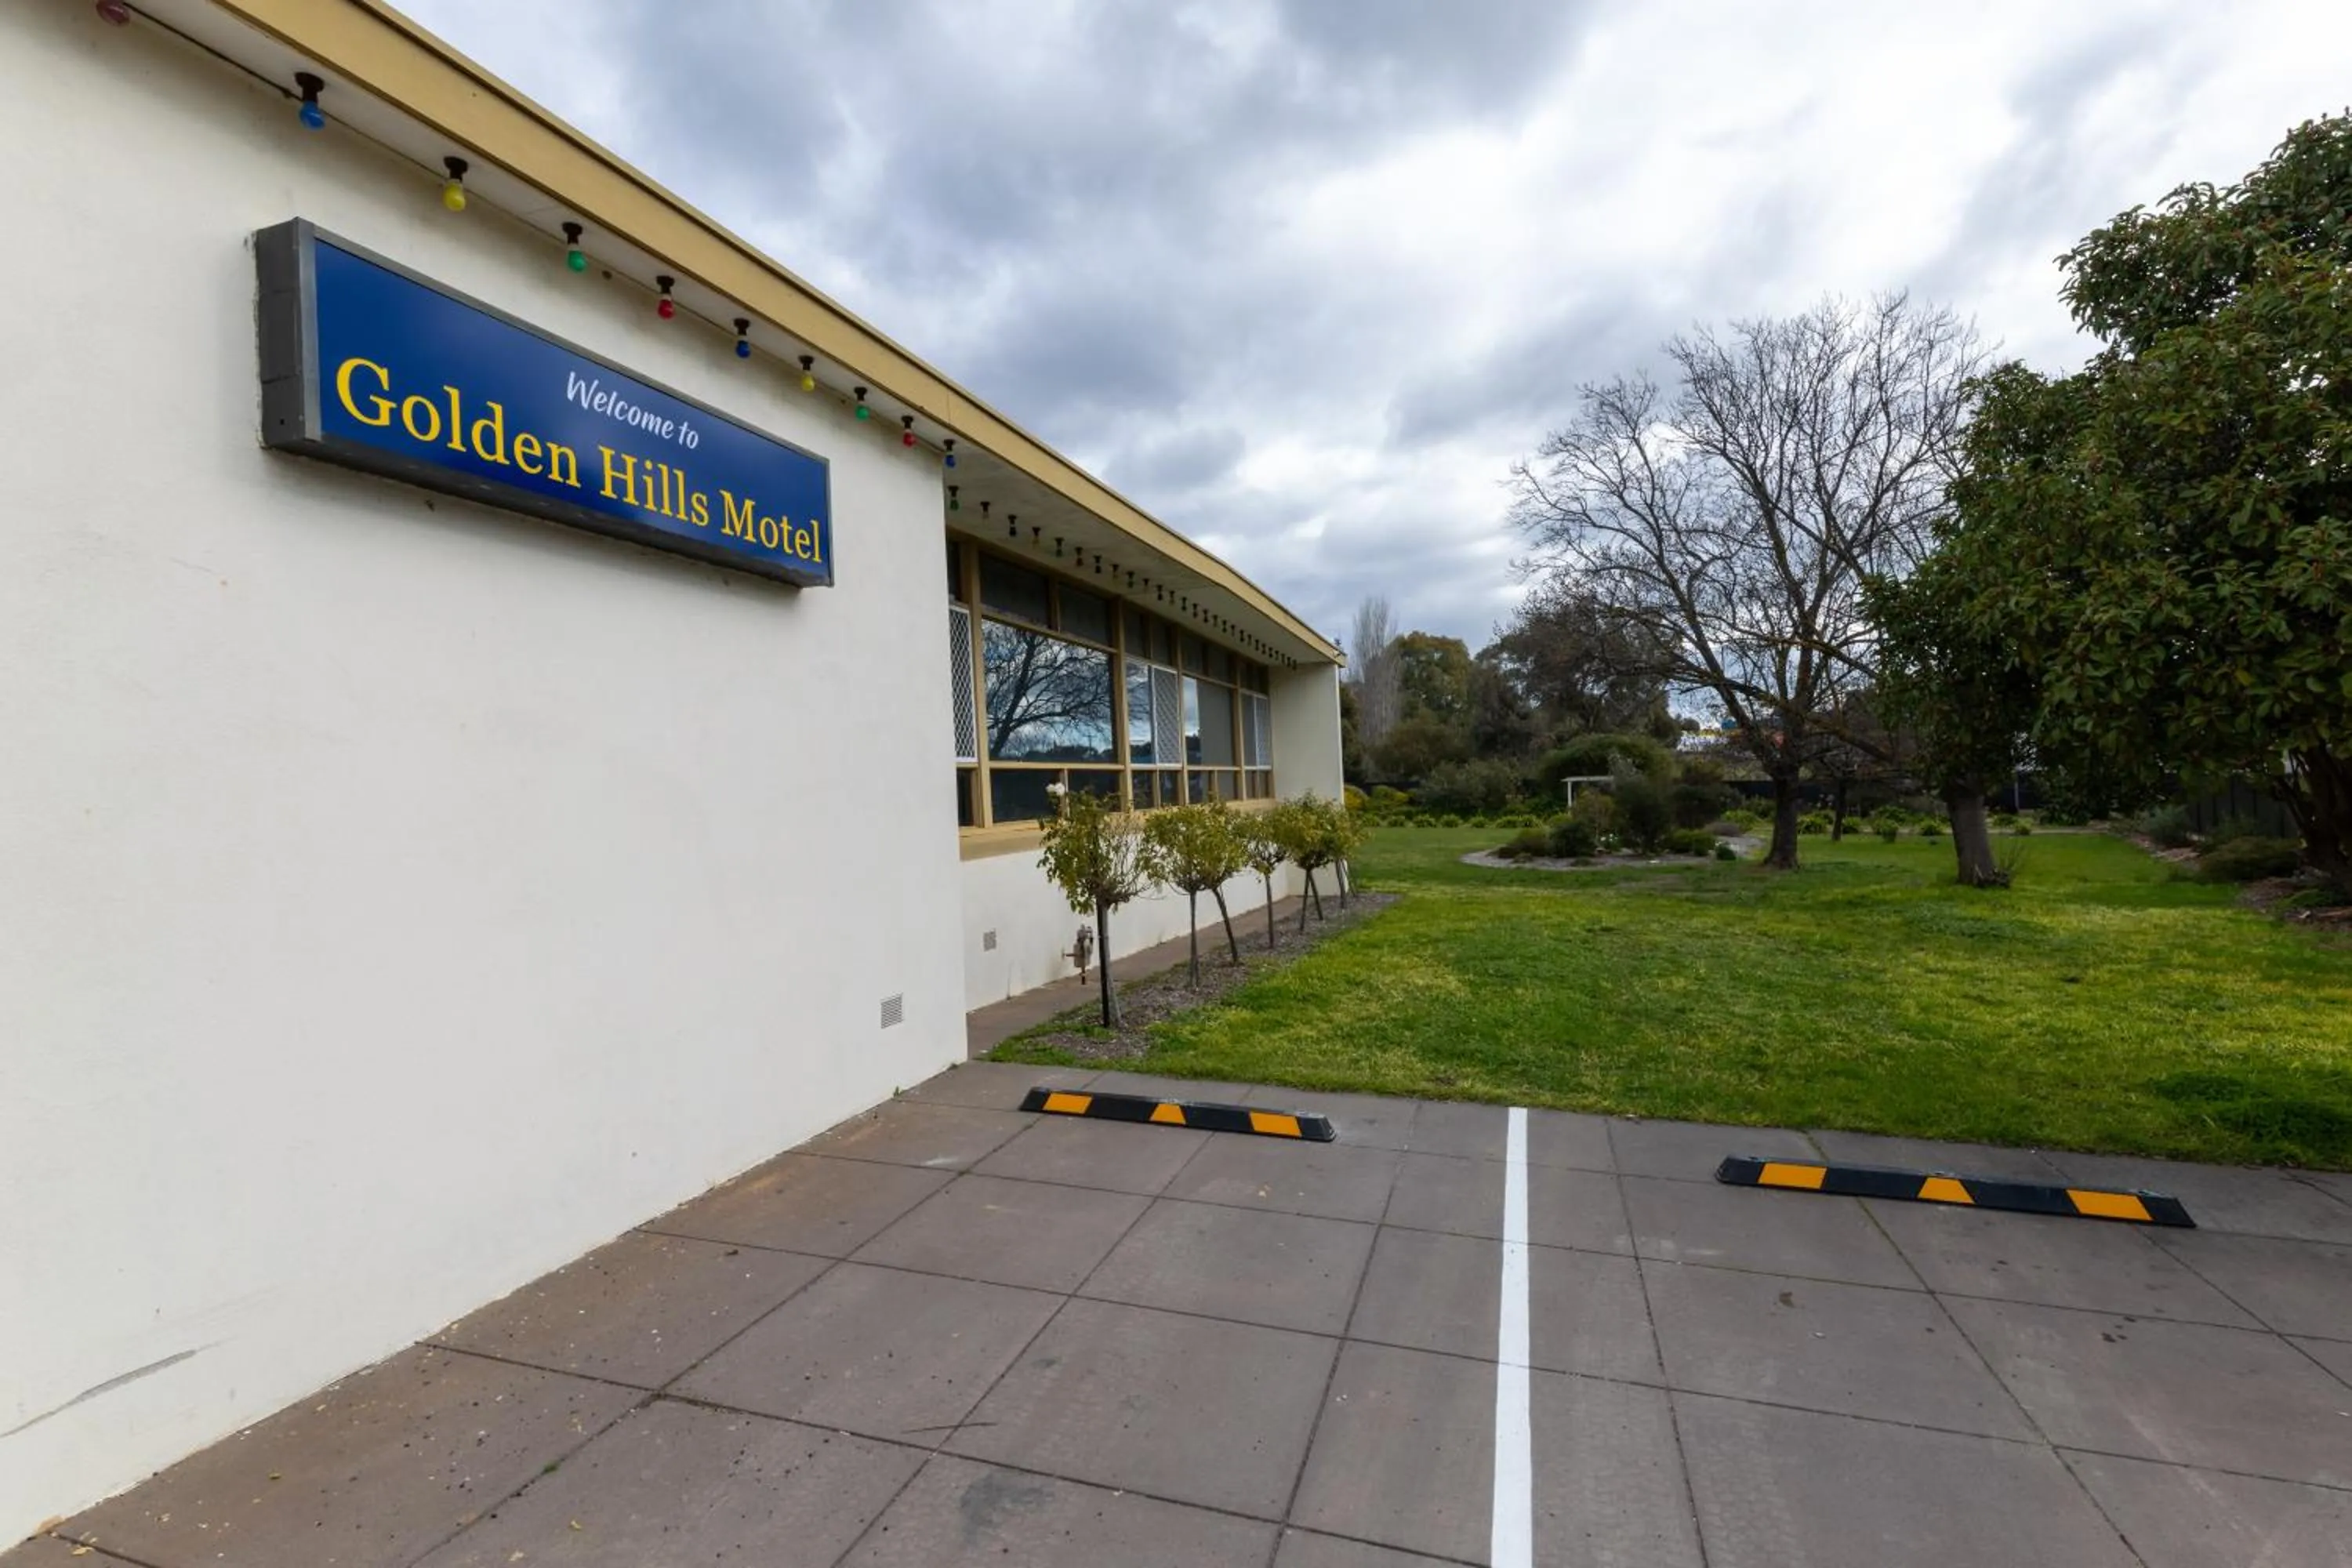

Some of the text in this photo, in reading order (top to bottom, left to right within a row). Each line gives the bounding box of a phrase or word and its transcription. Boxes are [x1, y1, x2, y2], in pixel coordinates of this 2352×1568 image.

[336, 357, 822, 563] Golden Hills Motel
[565, 370, 699, 450] Welcome to
